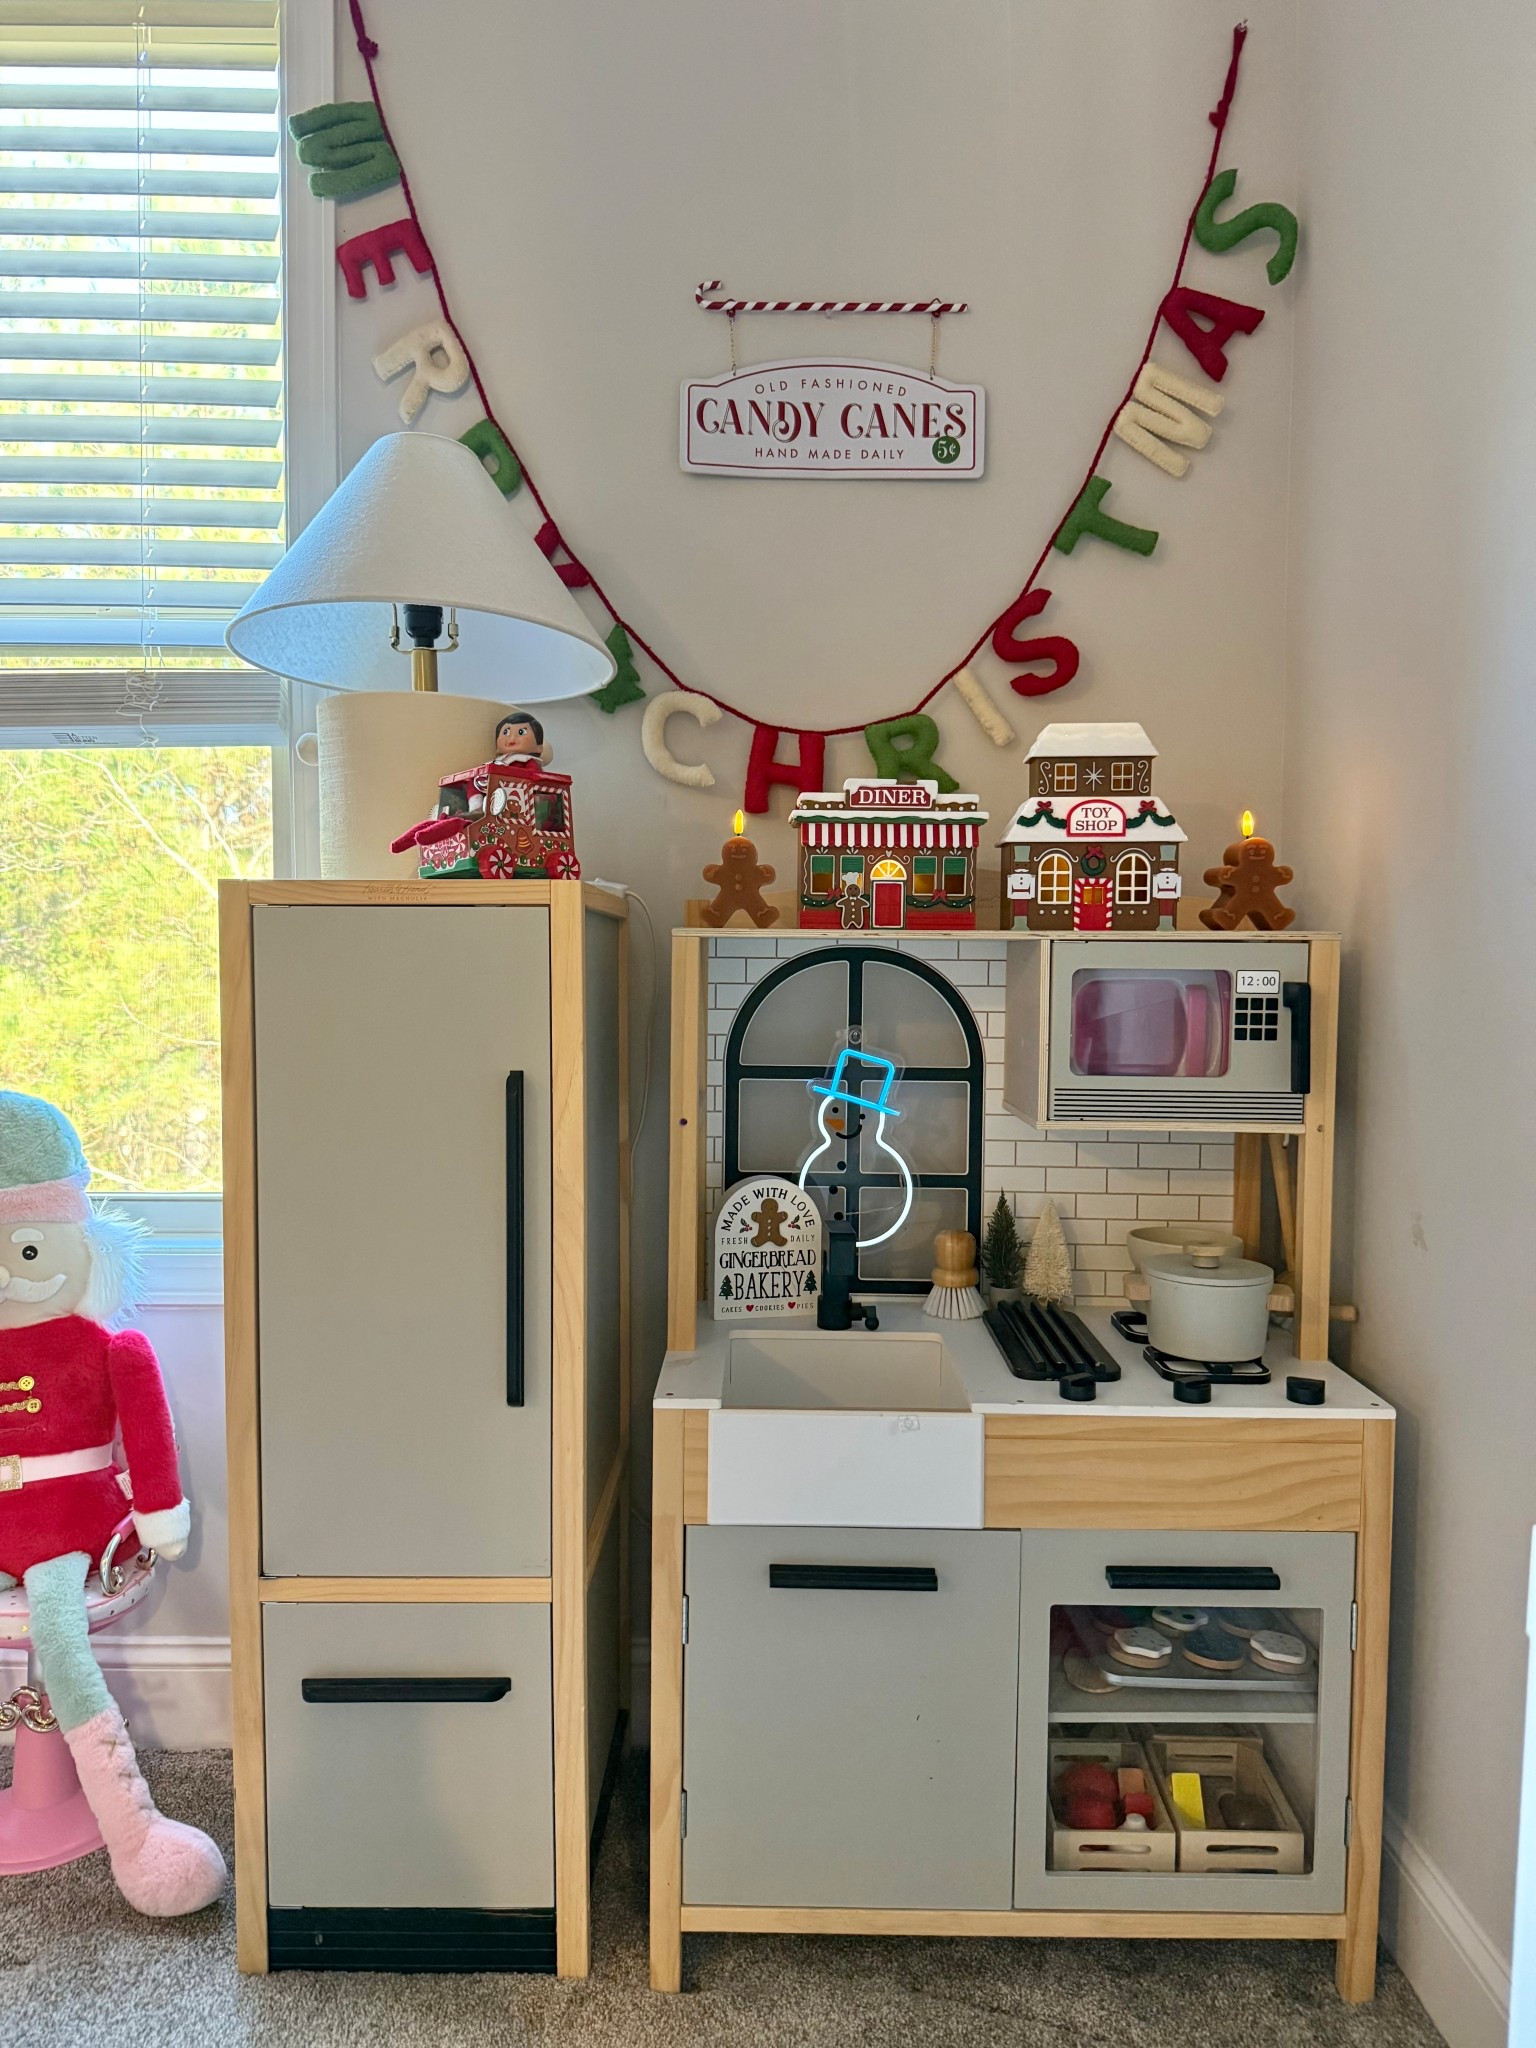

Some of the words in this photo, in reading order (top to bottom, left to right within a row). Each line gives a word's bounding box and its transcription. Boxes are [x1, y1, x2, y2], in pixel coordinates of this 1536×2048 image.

[754, 380, 788, 395] OLD
[801, 378, 907, 397] FASHIONED
[696, 398, 826, 443] CANDY
[840, 402, 967, 439] CANES
[754, 447, 799, 459] HAND
[808, 449, 852, 460] MADE
[861, 449, 905, 460] DAILY
[858, 788, 928, 806] DINER
[1080, 807, 1111, 819] TOY
[1075, 819, 1118, 832] SHOP
[721, 1195, 751, 1231] MADE
[753, 1187, 789, 1201] WITH
[790, 1195, 816, 1228] LOVE
[721, 1237, 748, 1245] FRESH
[790, 1234, 815, 1243] DAILY
[719, 1249, 817, 1270] GINGERBREAD
[733, 1270, 805, 1300] BAKERY
[755, 1304, 785, 1312] COOKIES
[796, 1302, 814, 1310] PIES
